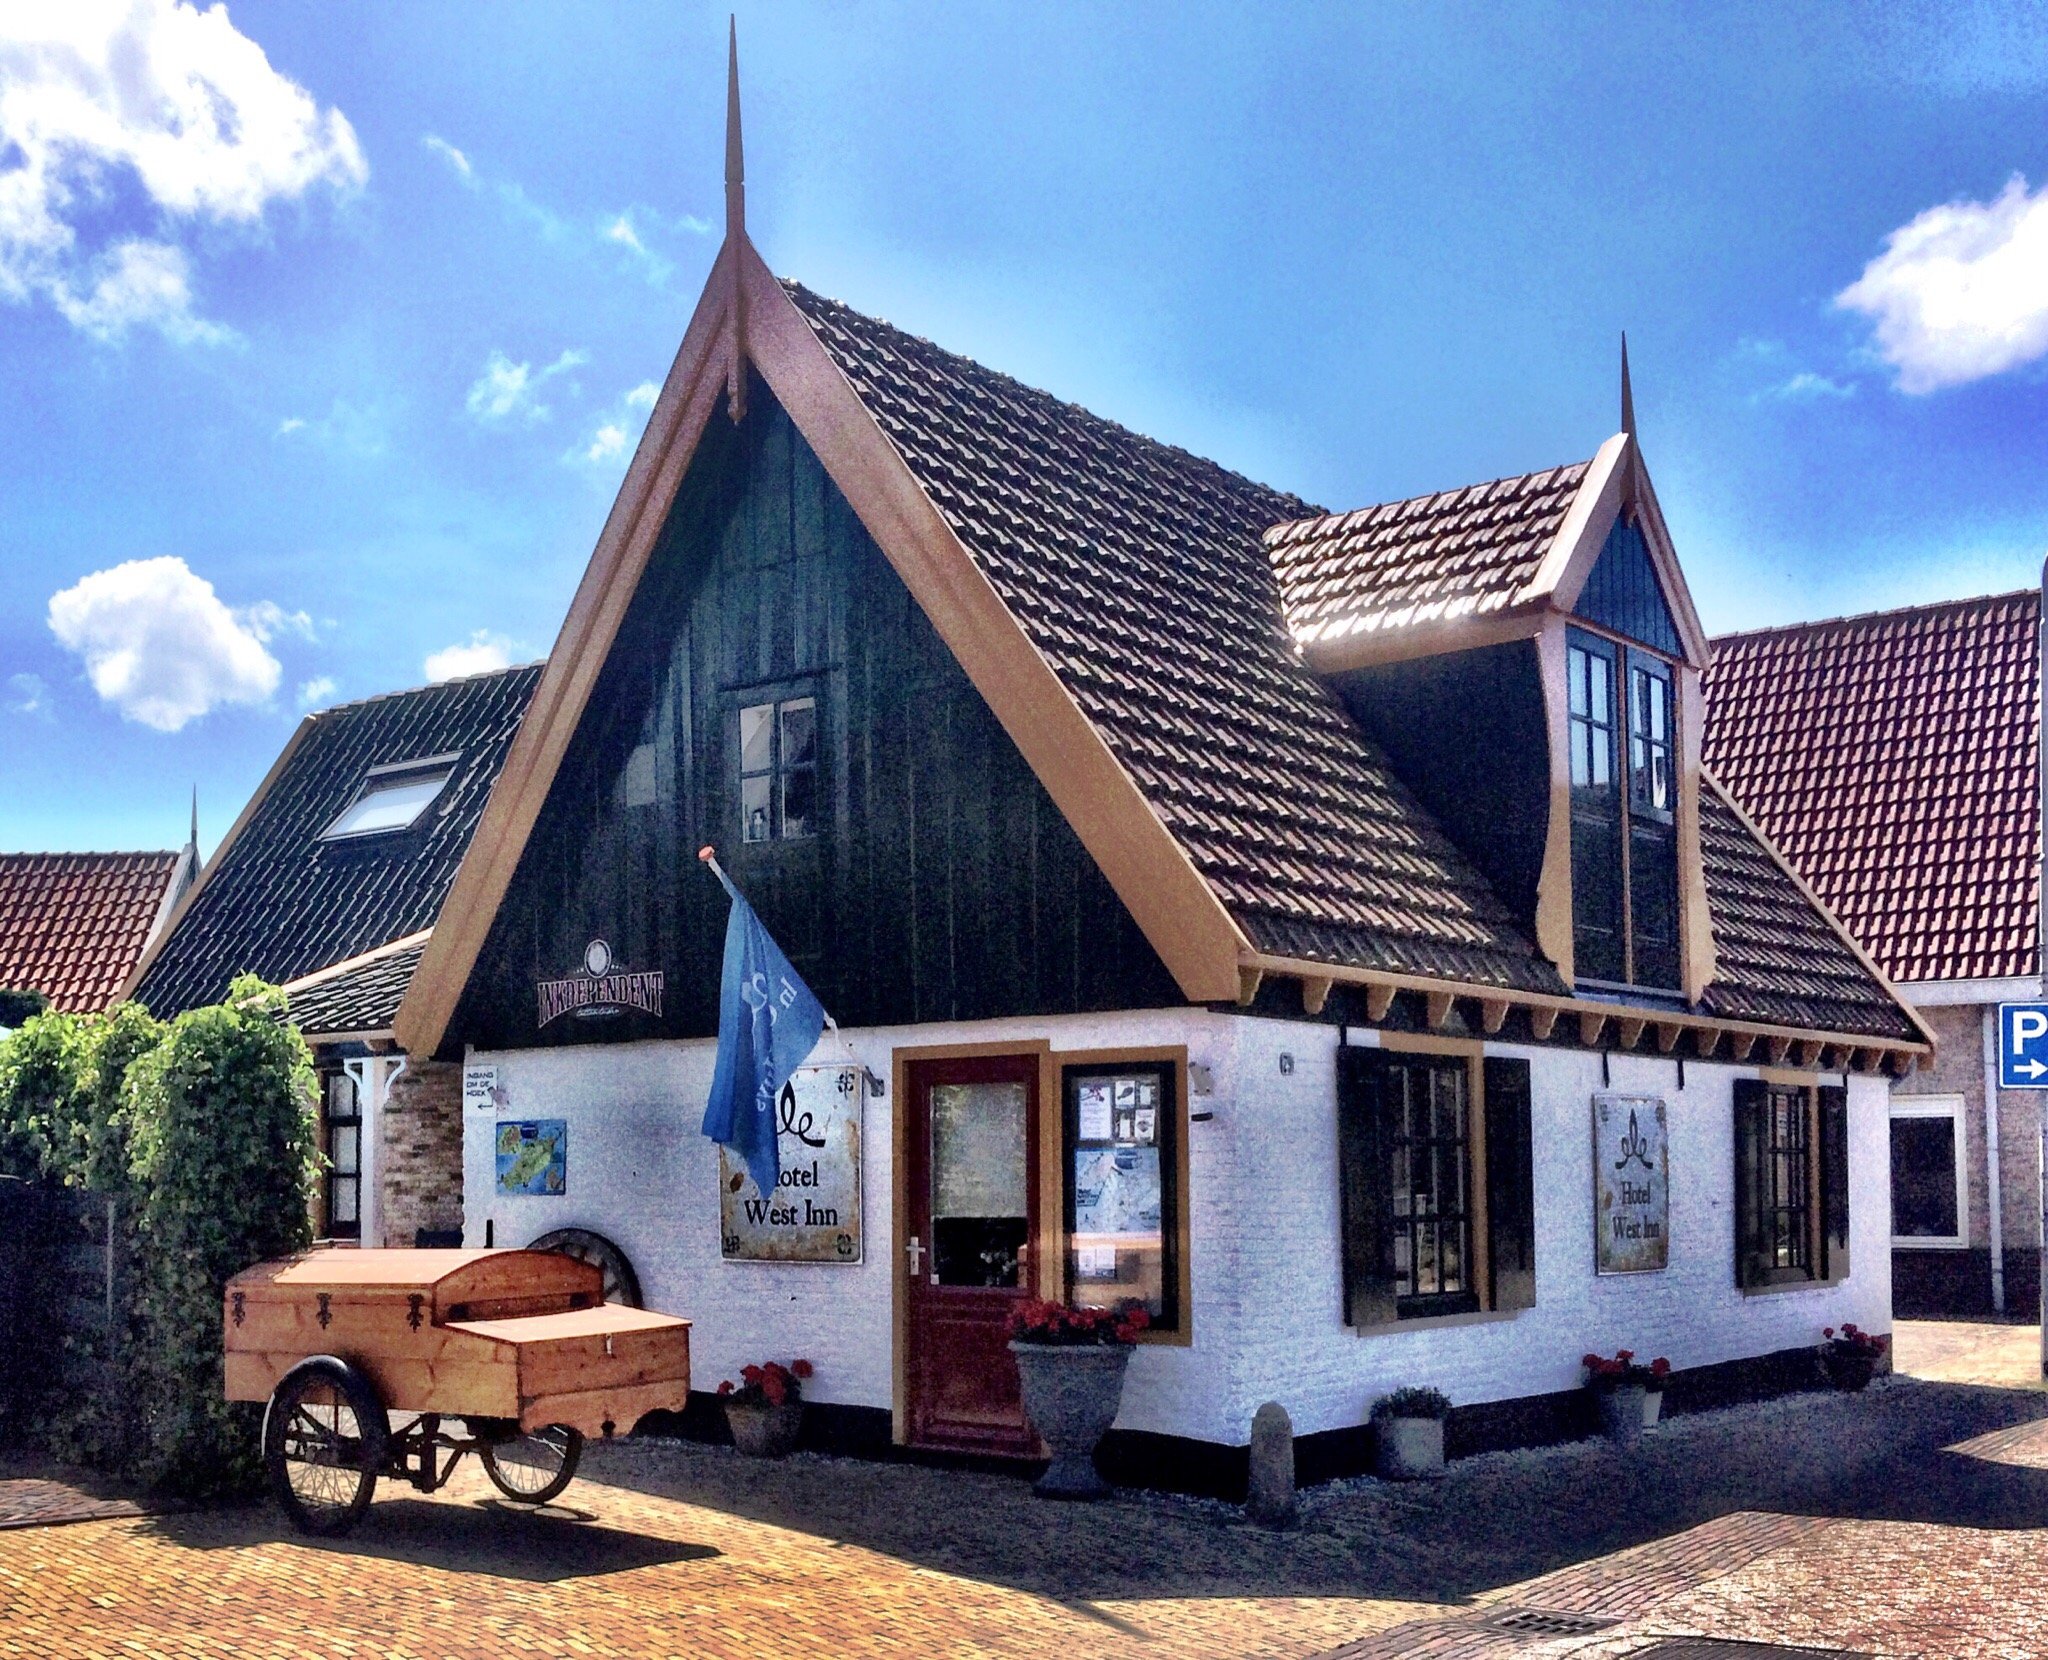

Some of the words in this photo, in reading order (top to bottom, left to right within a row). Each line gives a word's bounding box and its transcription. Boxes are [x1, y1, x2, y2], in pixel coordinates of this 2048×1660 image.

[538, 971, 663, 1028] INKDEPENDENT
[2012, 1010, 2048, 1055] P
[775, 1160, 819, 1187] otel
[1620, 1180, 1651, 1205] Hotel
[744, 1199, 798, 1226] West
[804, 1199, 838, 1226] Inn
[1612, 1216, 1641, 1240] West
[1644, 1215, 1660, 1239] Inn
